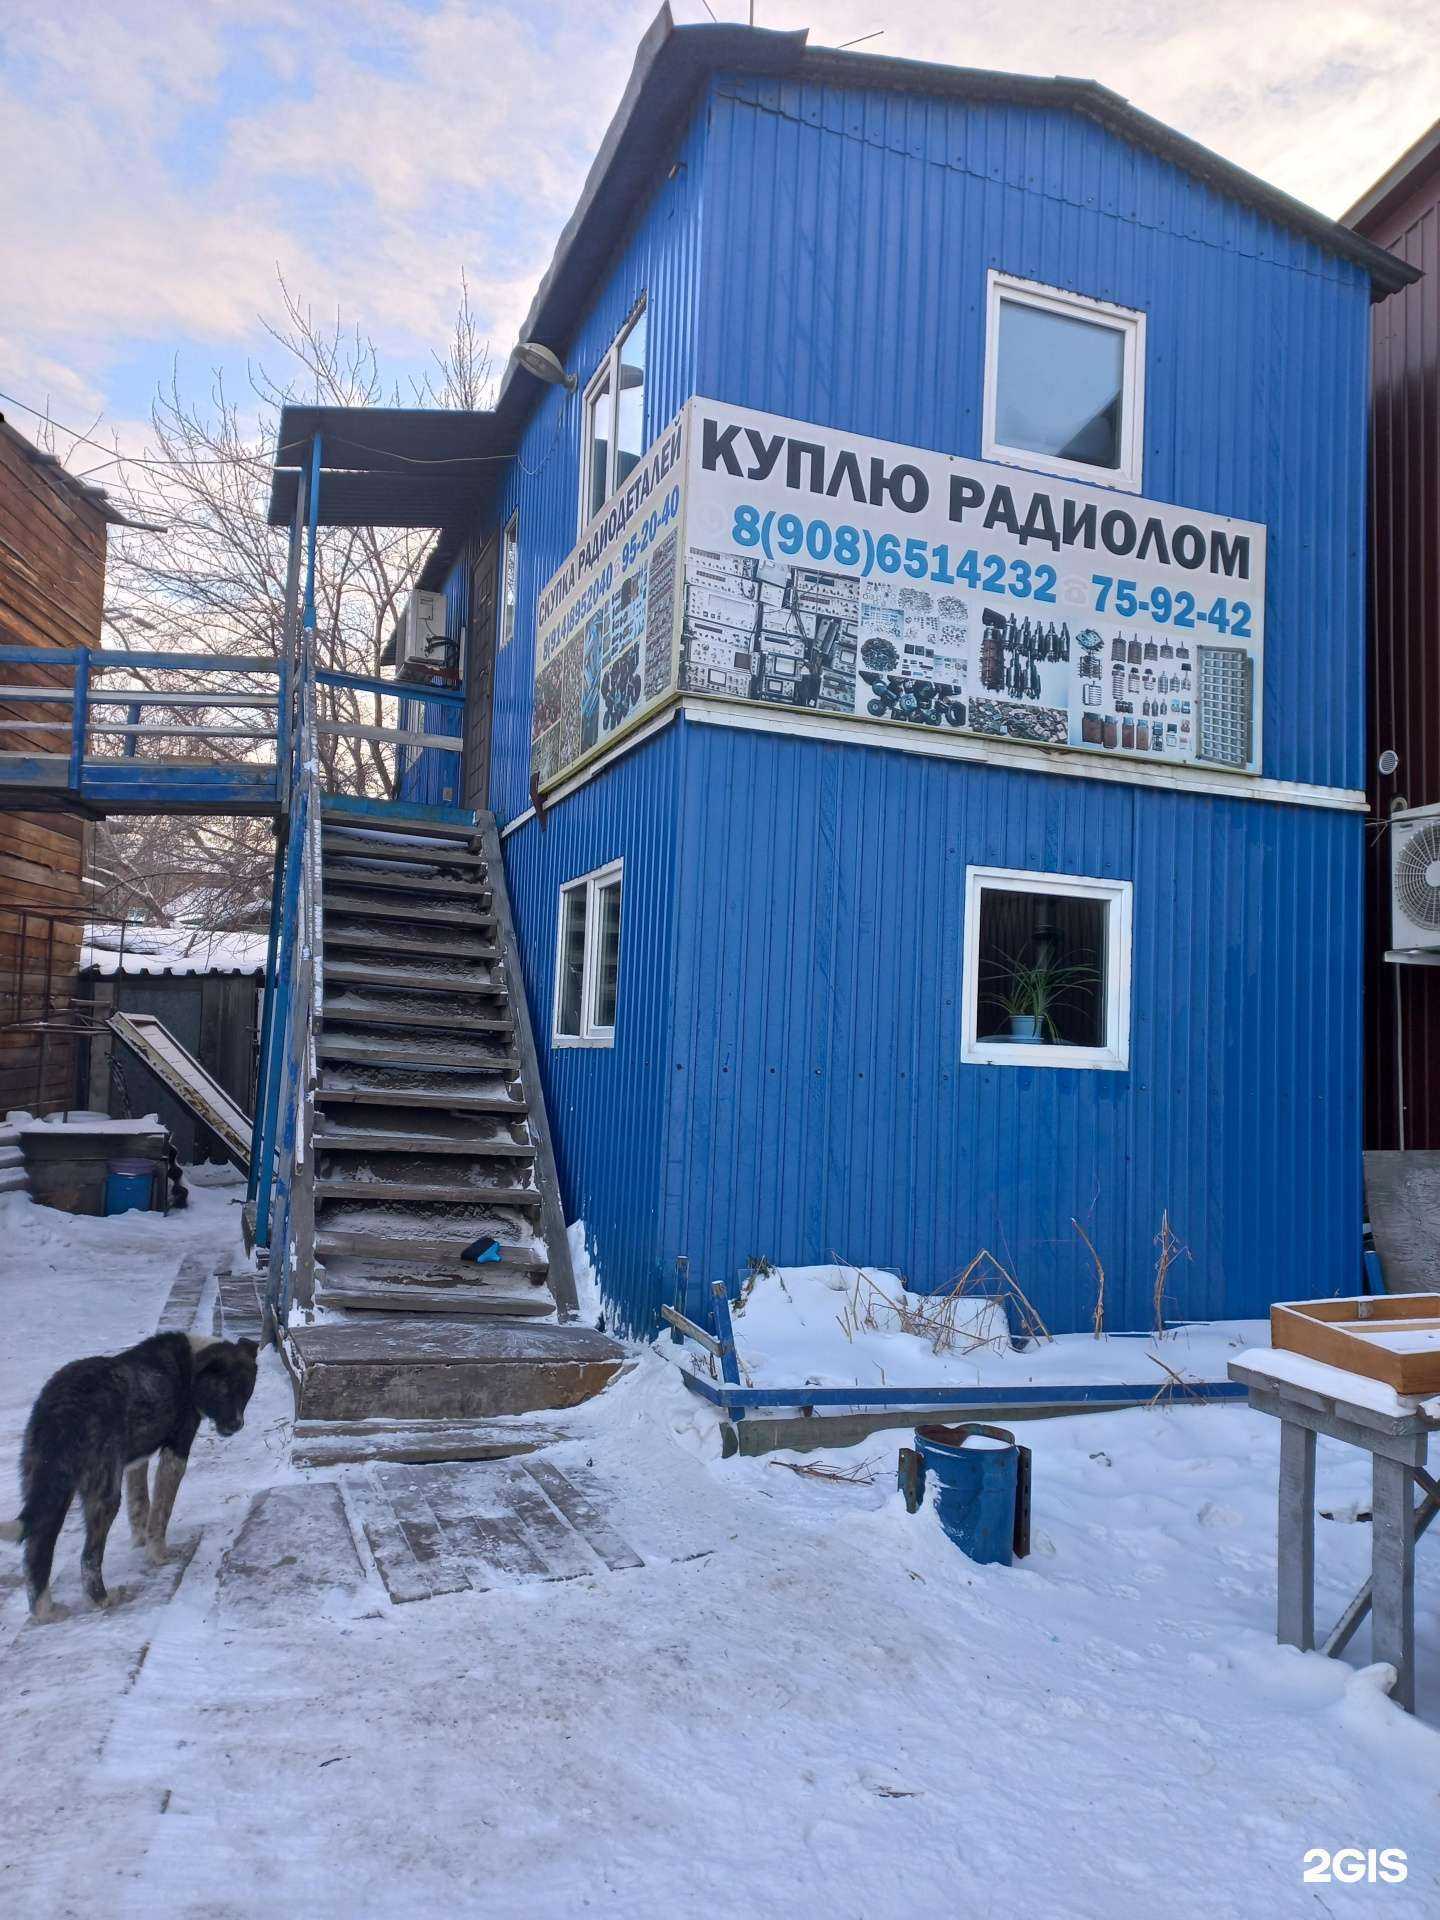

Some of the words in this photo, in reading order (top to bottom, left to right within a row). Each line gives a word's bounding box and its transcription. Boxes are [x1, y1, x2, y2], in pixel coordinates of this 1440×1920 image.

[539, 563, 575, 628] СКУПКА
[577, 415, 683, 580] РАДИОДЕТАЛЕЙ
[543, 562, 613, 661] 8(914)8952040
[621, 484, 680, 573] 95-20-40
[702, 418, 930, 513] КУПЛЮ
[948, 474, 1251, 580] РАДИОЛОМ
[732, 504, 1057, 604] 8(908)6514232
[1091, 574, 1252, 638] 75-92-42
